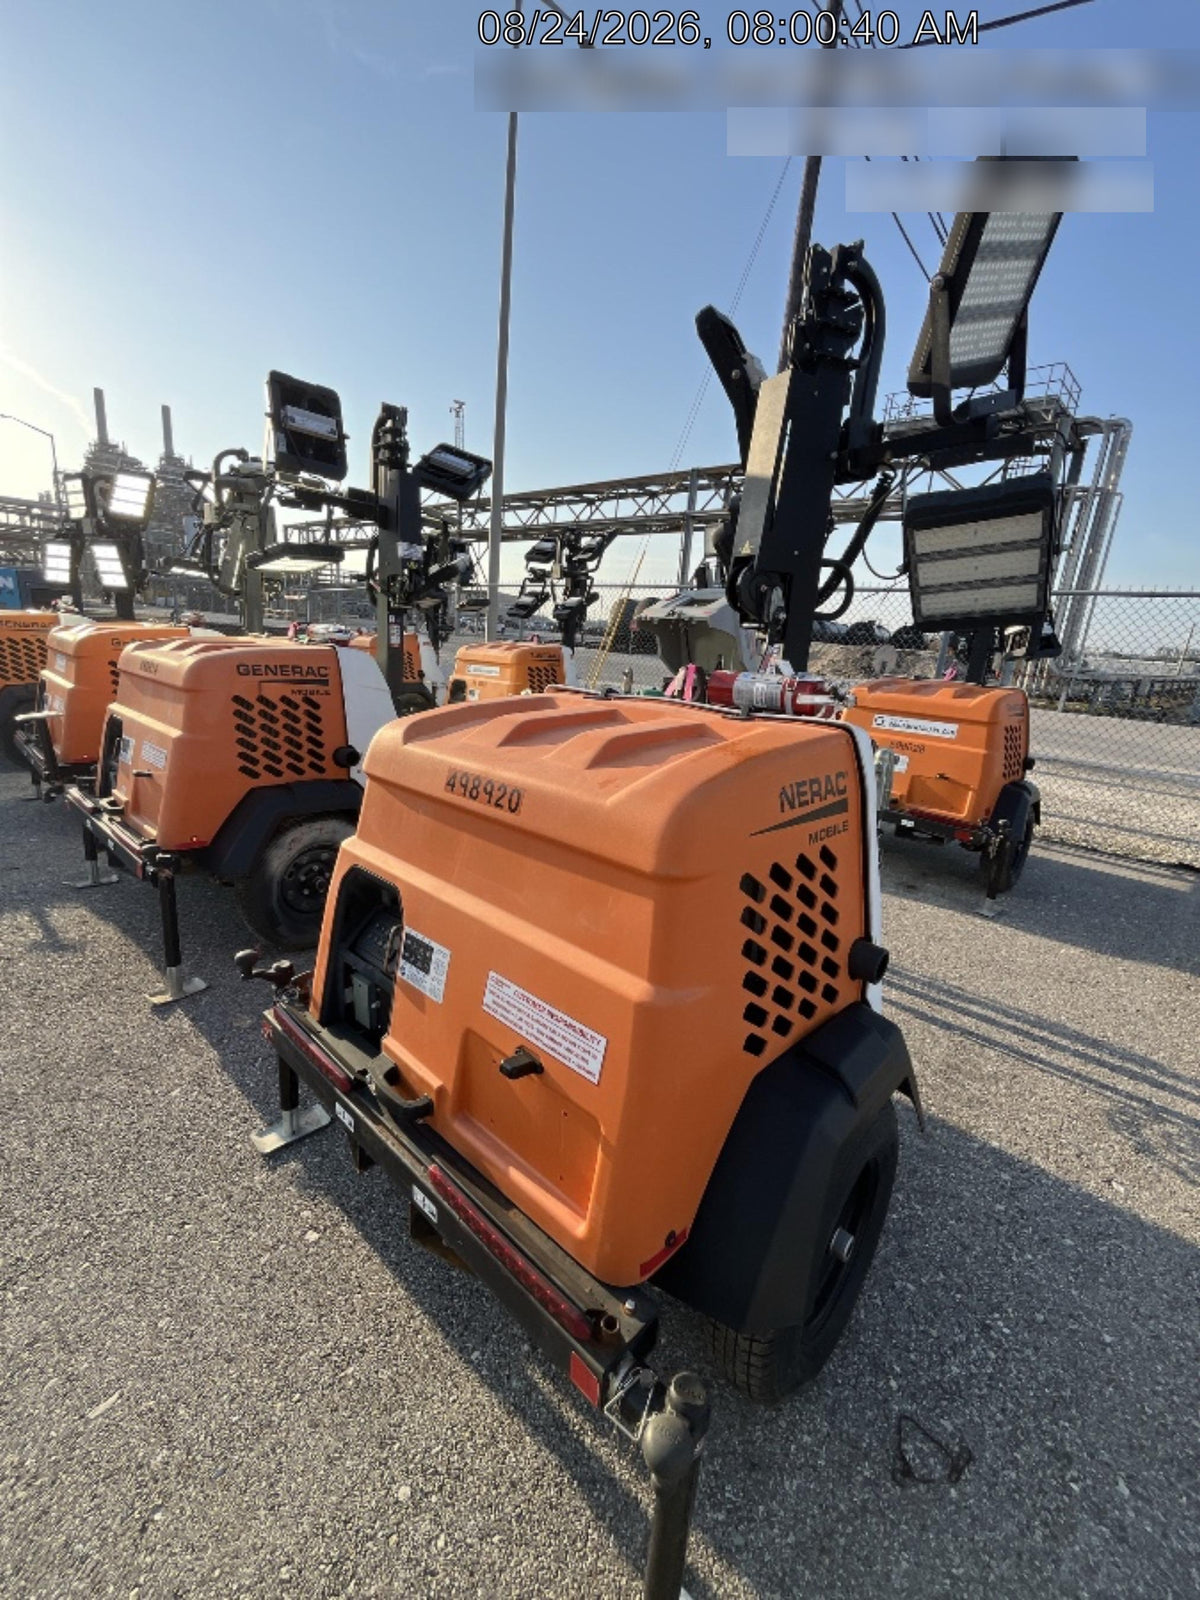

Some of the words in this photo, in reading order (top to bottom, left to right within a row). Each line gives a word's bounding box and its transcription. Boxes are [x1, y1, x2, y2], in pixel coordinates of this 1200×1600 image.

[236, 663, 330, 678] GENERAC
[445, 770, 521, 814] 498920
[779, 770, 847, 814] NERAC
